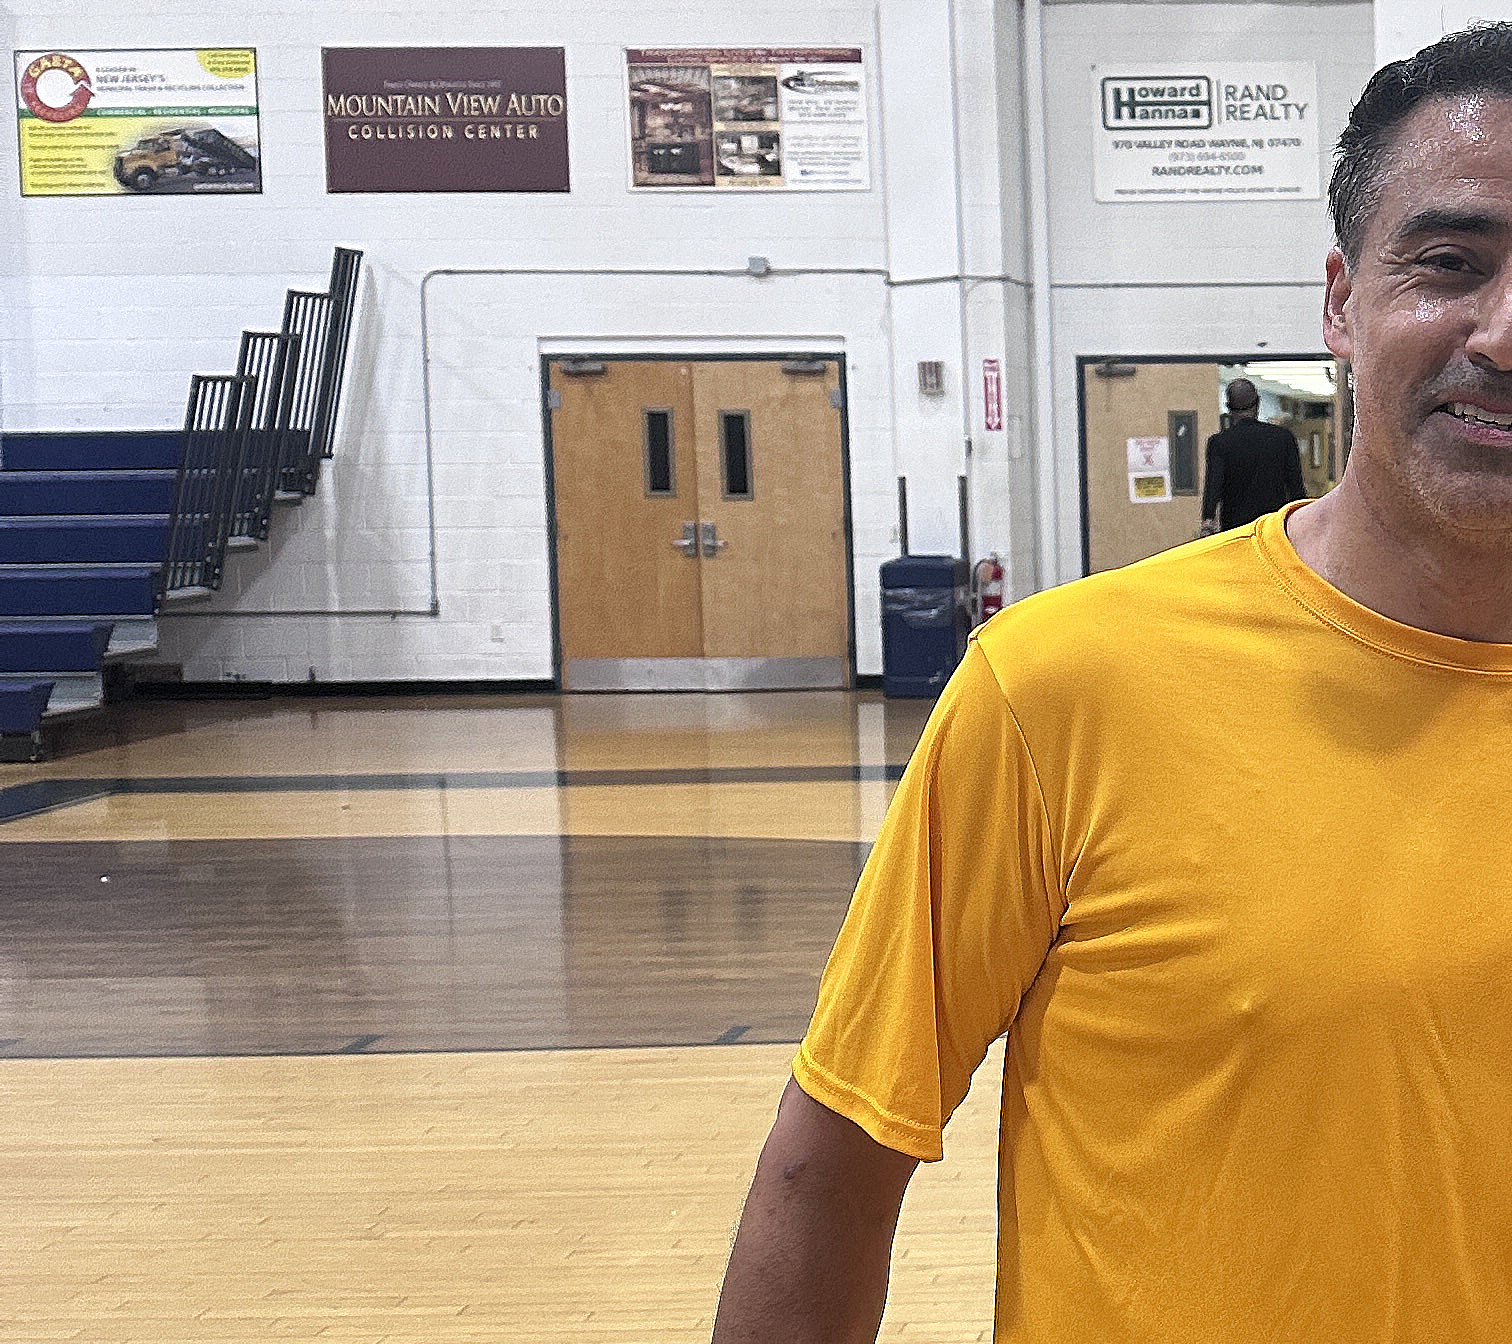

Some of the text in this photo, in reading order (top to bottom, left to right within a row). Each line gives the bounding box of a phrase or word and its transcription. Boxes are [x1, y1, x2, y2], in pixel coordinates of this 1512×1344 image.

[1112, 84, 1201, 108] Howard
[1224, 84, 1288, 101] RAND
[327, 92, 565, 116] MOUNTAIN VIEW AUTO
[1225, 103, 1309, 121] REALTY
[348, 124, 540, 139] COLLISION CENTER
[1174, 139, 1206, 149] ROAD
[1152, 164, 1264, 176] RANDREALTY.COM
